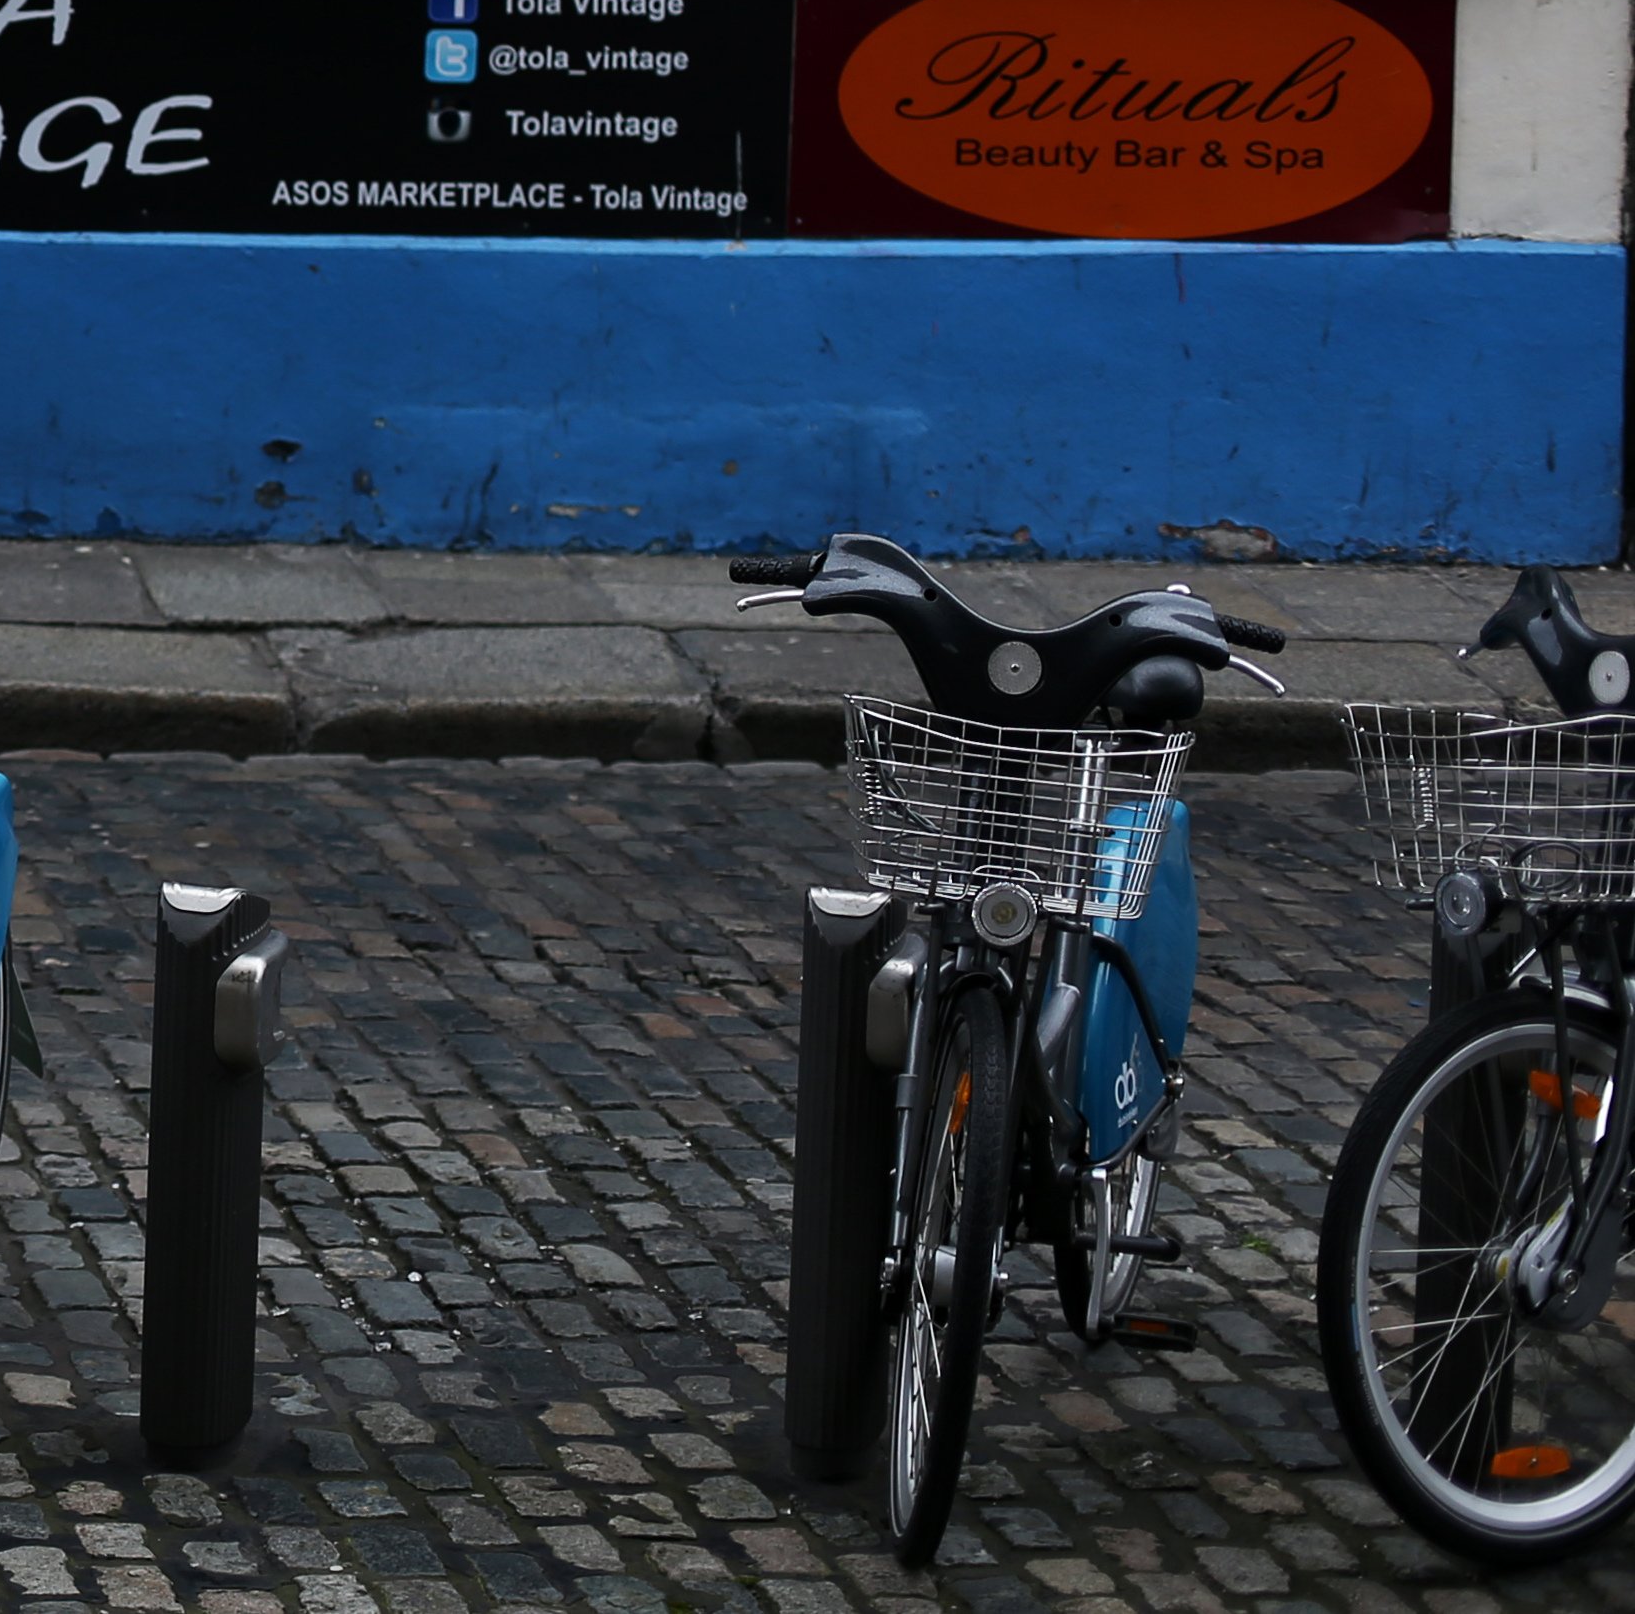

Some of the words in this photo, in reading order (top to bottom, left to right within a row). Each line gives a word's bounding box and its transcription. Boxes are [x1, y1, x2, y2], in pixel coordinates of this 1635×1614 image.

[488, 43, 690, 77] @tola_vintage
[895, 30, 1356, 123] Rituals
[505, 109, 679, 143] Tolavintage
[956, 138, 1098, 174] Beauty
[1114, 139, 1186, 168] Bar
[1200, 140, 1228, 169] &
[1244, 141, 1324, 175] Spa
[272, 181, 350, 208] ASOS
[357, 181, 565, 210] MARKETPLACE
[590, 184, 643, 211] Tola
[650, 185, 749, 217] Vintage
